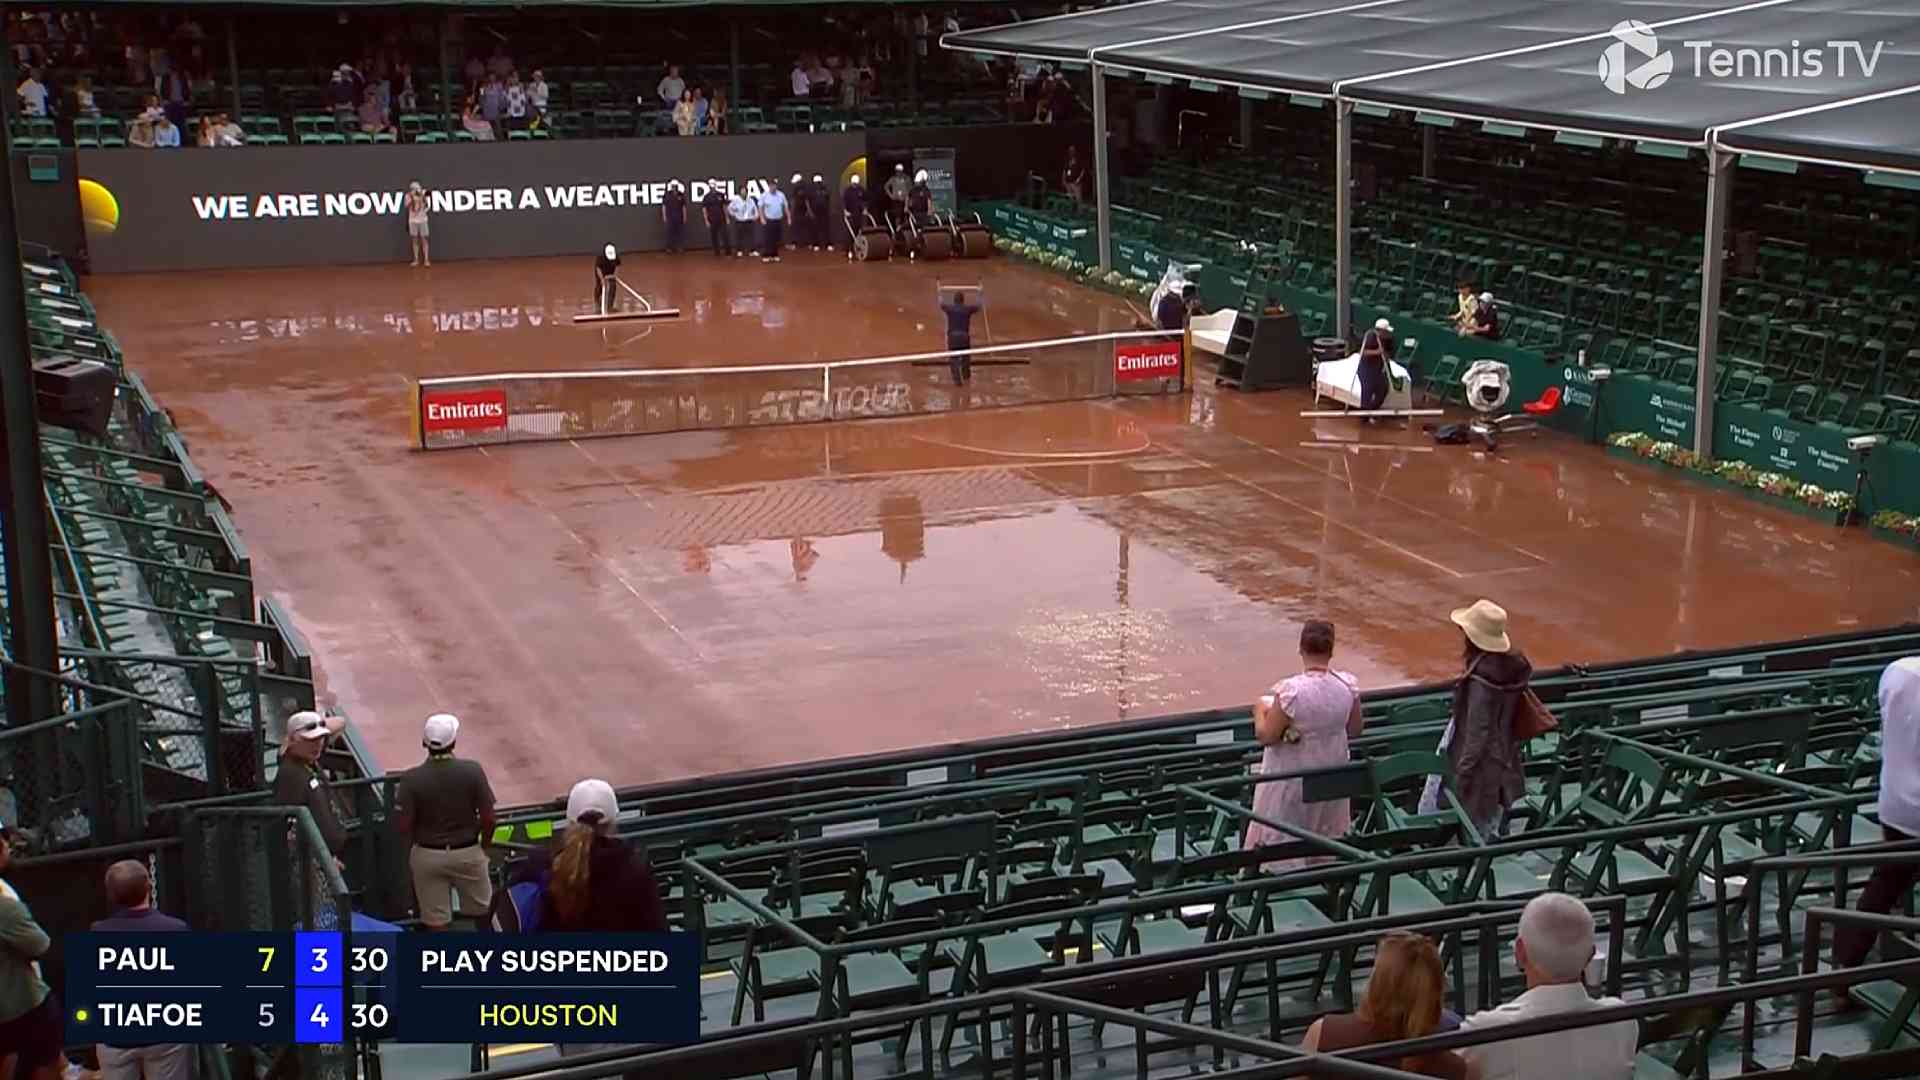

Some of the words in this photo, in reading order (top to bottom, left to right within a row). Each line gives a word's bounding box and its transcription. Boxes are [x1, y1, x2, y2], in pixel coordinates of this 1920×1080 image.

[192, 194, 249, 219] WE
[254, 193, 319, 218] ARE
[324, 191, 403, 216] NOW
[426, 187, 513, 213] NDER
[518, 187, 541, 209] A
[1117, 353, 1178, 371] Emirates
[427, 401, 503, 420] Emirates
